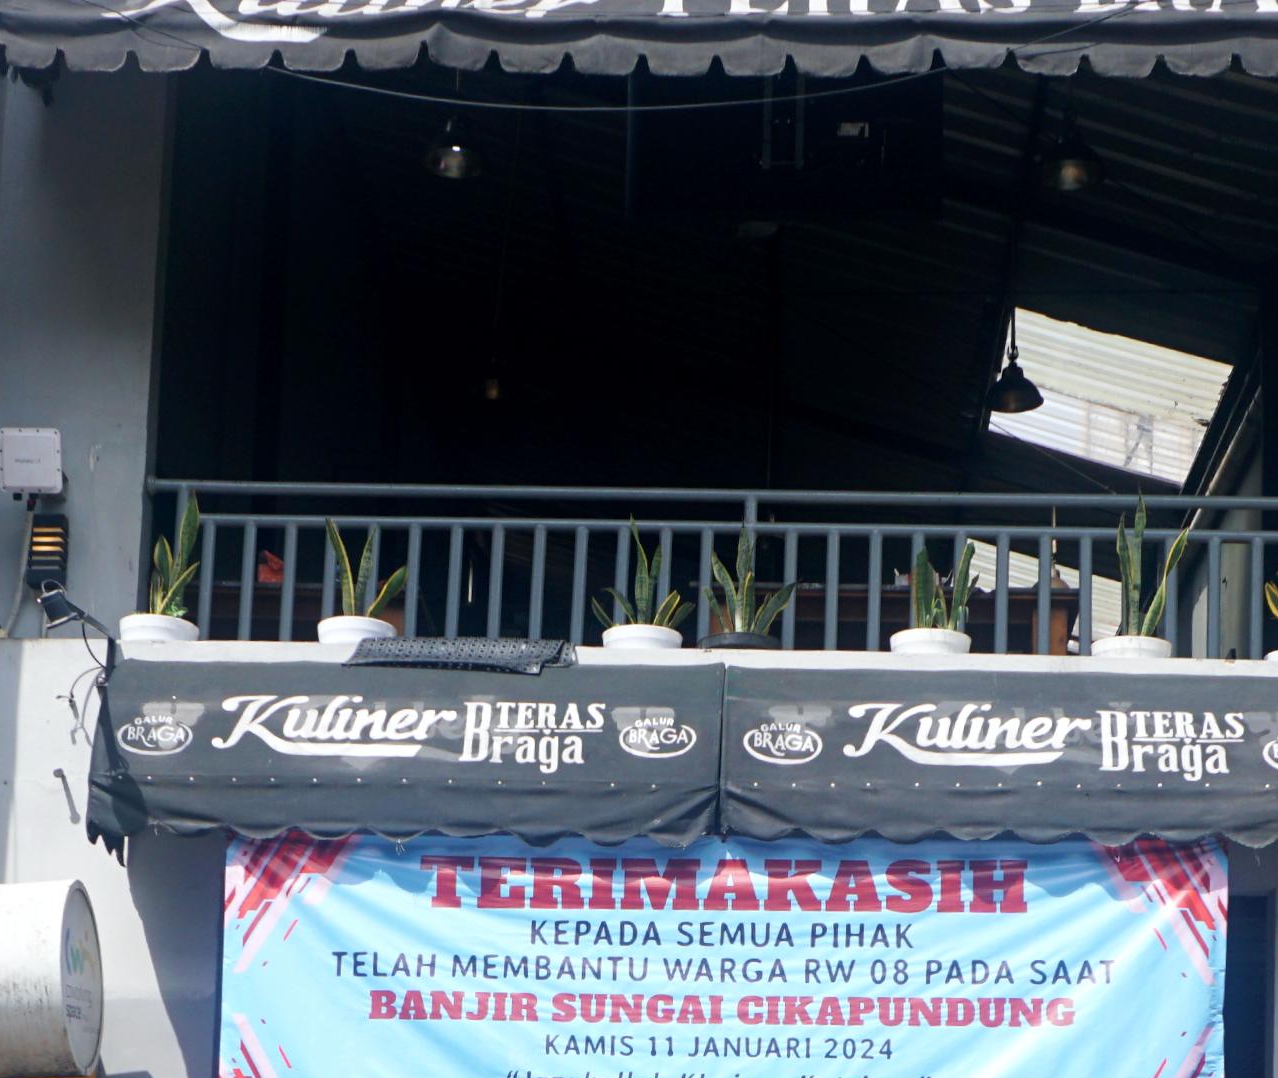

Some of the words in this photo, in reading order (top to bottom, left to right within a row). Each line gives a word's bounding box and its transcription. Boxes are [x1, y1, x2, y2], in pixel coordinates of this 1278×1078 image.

[134, 715, 173, 725] GALUR
[212, 695, 457, 757] Kuliner
[495, 701, 606, 730] TERAS
[635, 718, 675, 729] GALUR
[1132, 710, 1245, 741] TERAS
[127, 725, 185, 747] BRAGA
[459, 701, 584, 773] Braga
[626, 726, 689, 750] BRAGA
[753, 731, 816, 755] BRAGA
[842, 702, 1092, 768] Kuliner
[1097, 710, 1231, 782] Braga
[420, 856, 1028, 913] TERIMAKASIH
[530, 919, 662, 947] KEPADA
[676, 921, 795, 948] SEMUA
[810, 922, 914, 949] PIHAK
[331, 951, 436, 978] TELAH
[451, 954, 649, 982] MEMBANTU
[662, 957, 788, 983] WARGA
[804, 958, 856, 984] RW
[870, 958, 909, 986] 08
[925, 959, 1015, 985] PADA
[1029, 959, 1116, 985] SAAT
[370, 990, 538, 1022] BANJIR
[552, 993, 723, 1025] SUNGAI
[736, 995, 1075, 1028] CIKAPUNDUNG
[545, 1034, 634, 1057] KAMIS
[648, 1036, 674, 1057] 11
[687, 1036, 811, 1059] JANUARI
[824, 1038, 893, 1060] 2024
